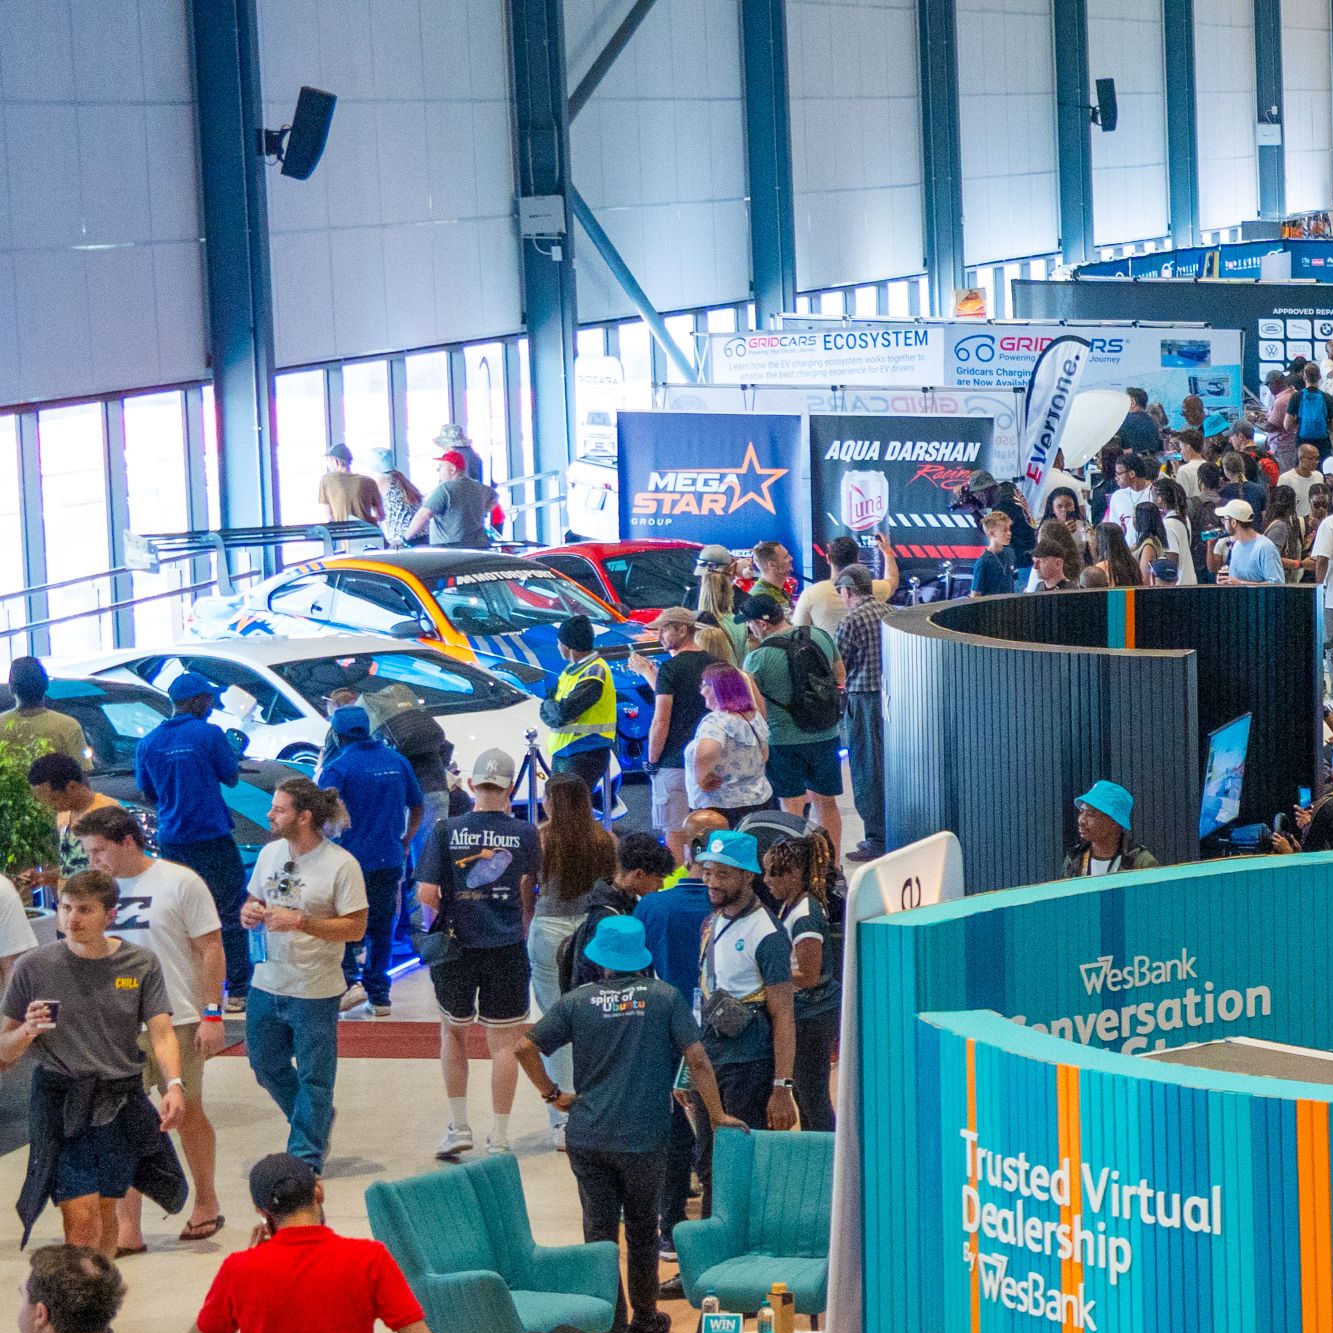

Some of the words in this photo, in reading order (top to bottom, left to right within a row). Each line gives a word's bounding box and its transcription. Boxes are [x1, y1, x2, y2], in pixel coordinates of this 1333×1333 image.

[1272, 308, 1314, 316] APPROVED
[748, 335, 817, 349] GRIDCARS
[823, 330, 929, 350] ECOSYSTEM
[1000, 336, 1124, 353] GRIDRS
[729, 362, 749, 370] Learn
[1000, 354, 1036, 363] Powering
[1089, 356, 1120, 364] Journey
[956, 366, 993, 376] Gridcars
[996, 367, 1034, 378] Chargin
[973, 378, 994, 386] Now
[996, 377, 1029, 386] Availab
[825, 440, 880, 462] AQUA
[884, 441, 981, 462] DARSHAN
[648, 473, 740, 492] MEGA
[632, 493, 728, 515] STAR
[728, 549, 754, 557] MEG
[450, 827, 481, 846] After
[483, 829, 520, 848] Hours
[1079, 947, 1198, 996] WesBank
[590, 993, 620, 1006] spirit
[603, 999, 645, 1012] Ubuntu
[1008, 981, 1272, 1046] nversation
[960, 1128, 1071, 1206] Trusted
[1082, 1163, 1222, 1235] Virtual
[962, 1184, 1132, 1286] Dealership
[963, 1241, 976, 1272] By
[978, 1252, 1098, 1332] WesBank
[709, 1318, 737, 1330] WIN
